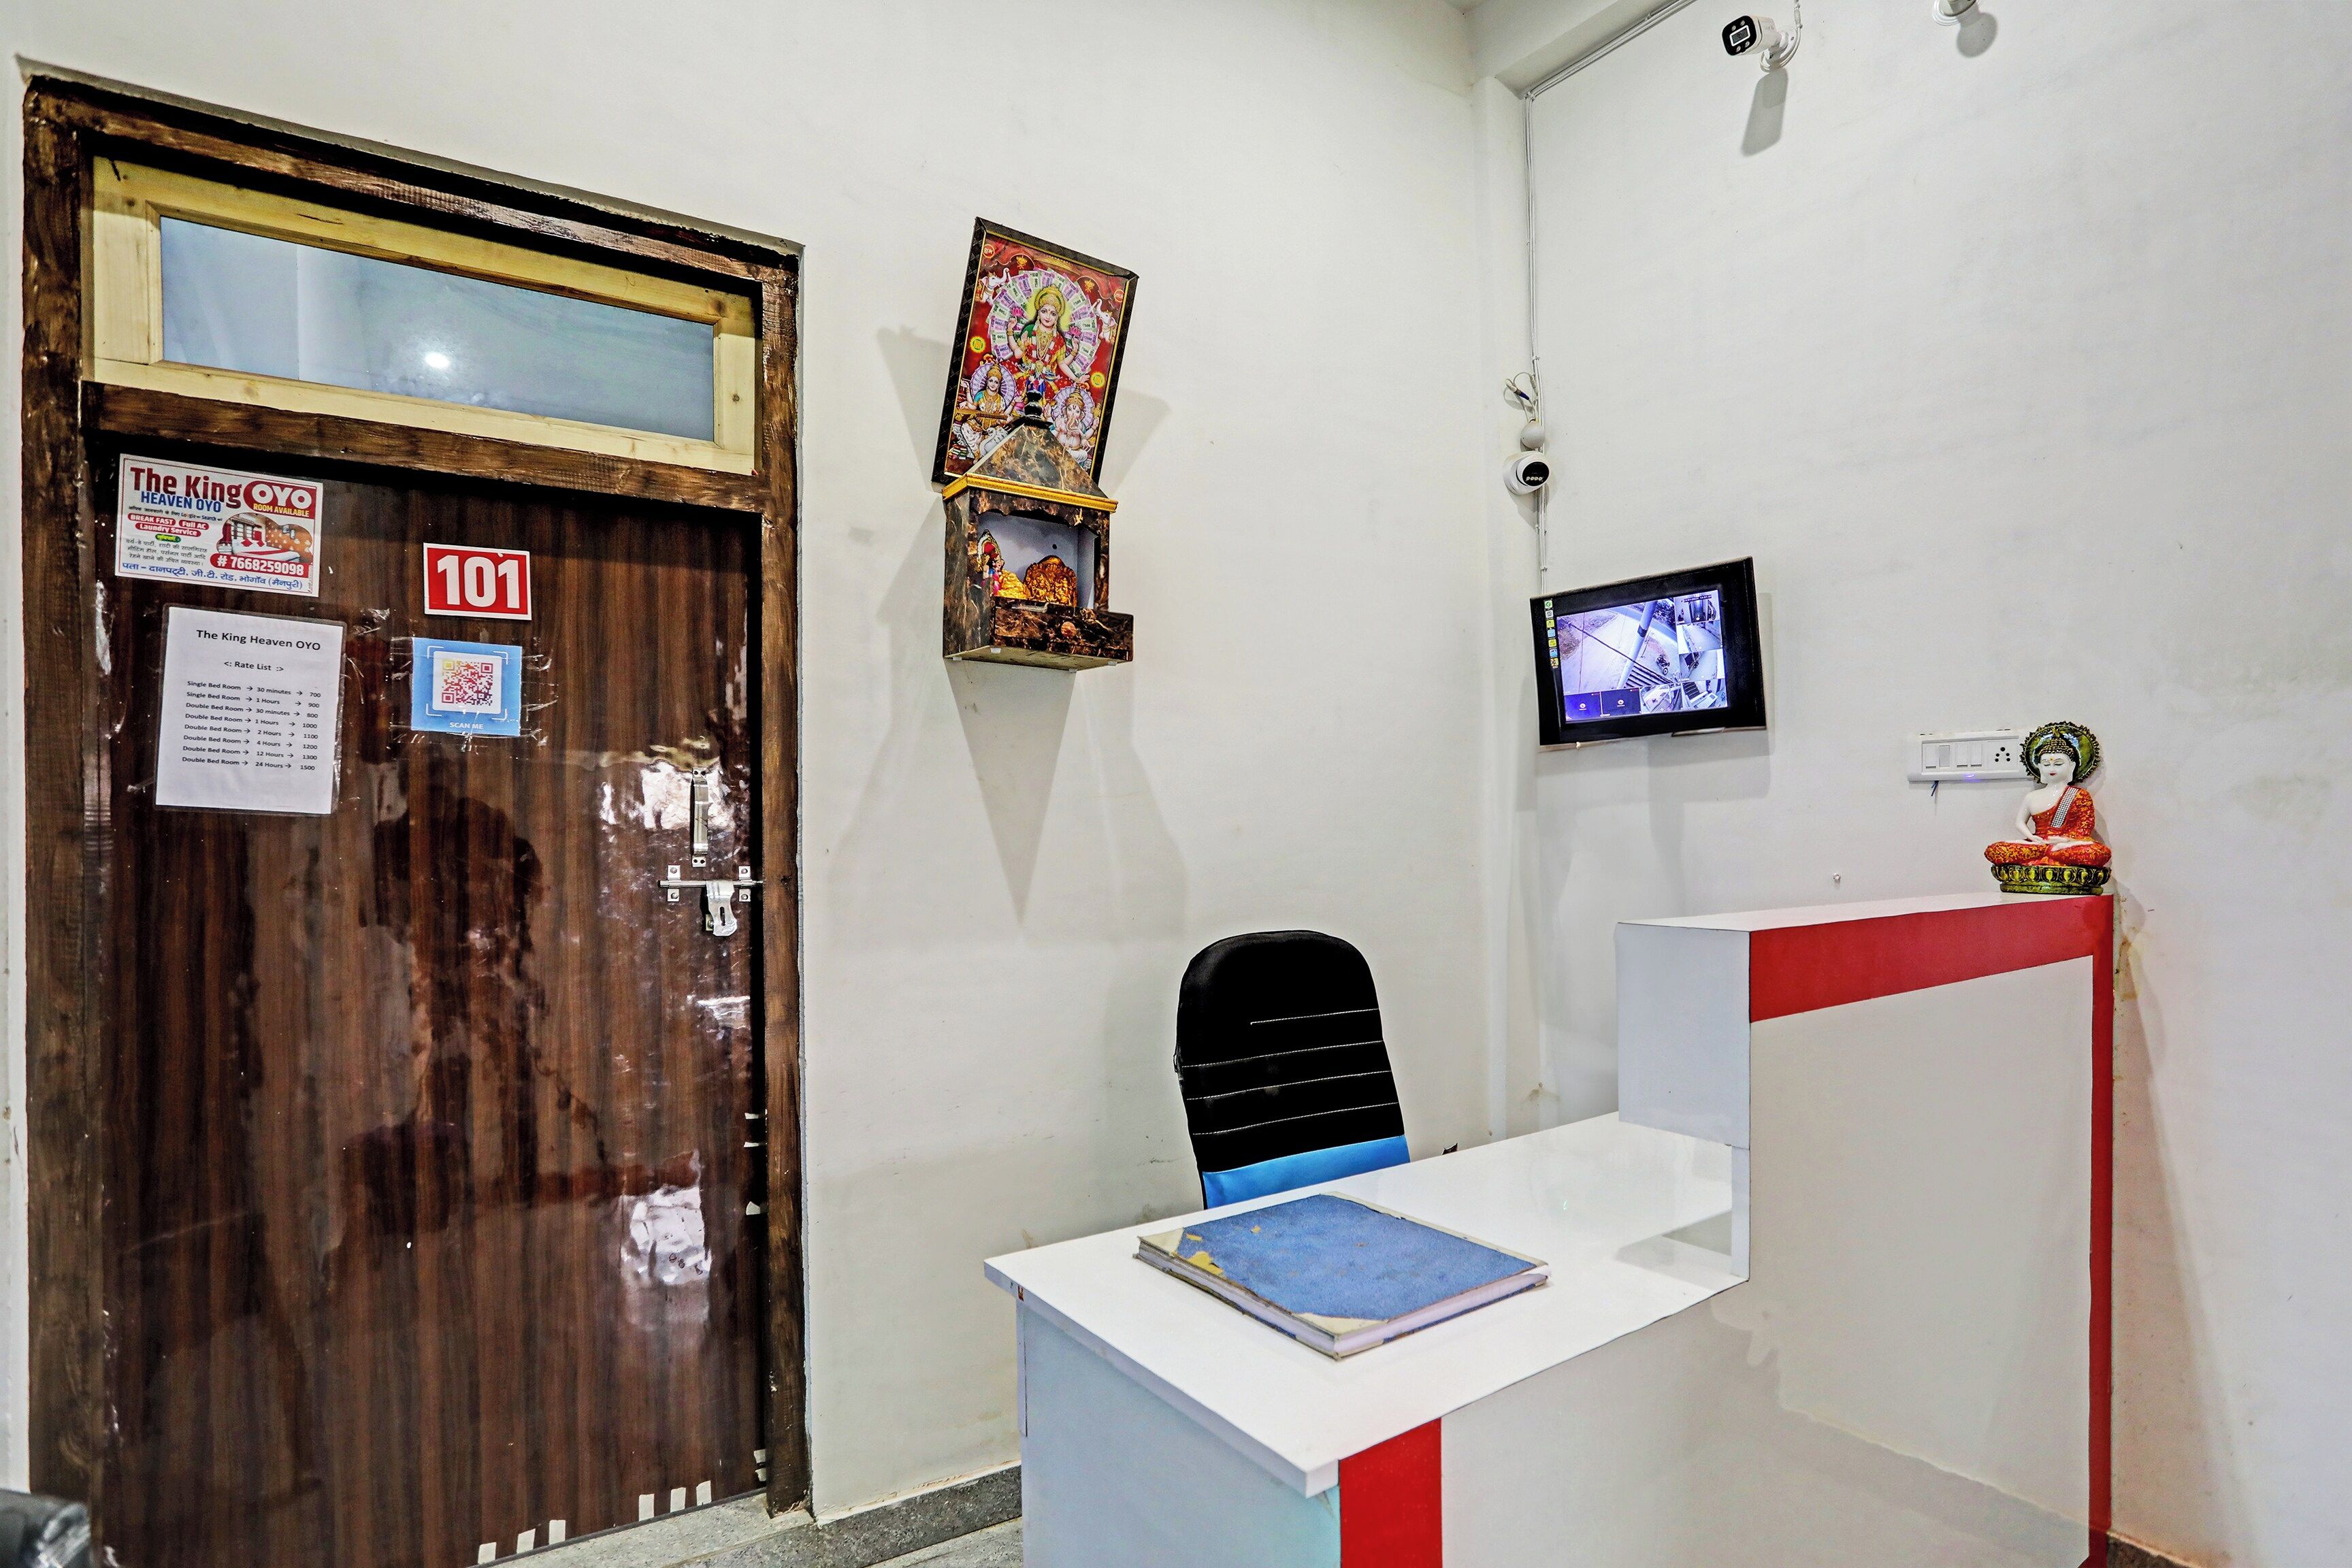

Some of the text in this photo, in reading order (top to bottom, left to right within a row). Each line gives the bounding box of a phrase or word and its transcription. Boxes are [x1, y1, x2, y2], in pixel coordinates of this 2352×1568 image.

[130, 467, 242, 508] The King
[252, 484, 312, 509] OYO
[141, 491, 221, 512] HEAVEN OYO
[253, 504, 310, 517] ROOM AVAILABLE
[131, 514, 174, 525] BREAK FAST
[140, 523, 197, 536] Laundry Service
[122, 562, 139, 570] पता
[230, 556, 304, 576] 7668259098
[437, 555, 520, 610] 101
[197, 630, 321, 651] The King Heaven OYO
